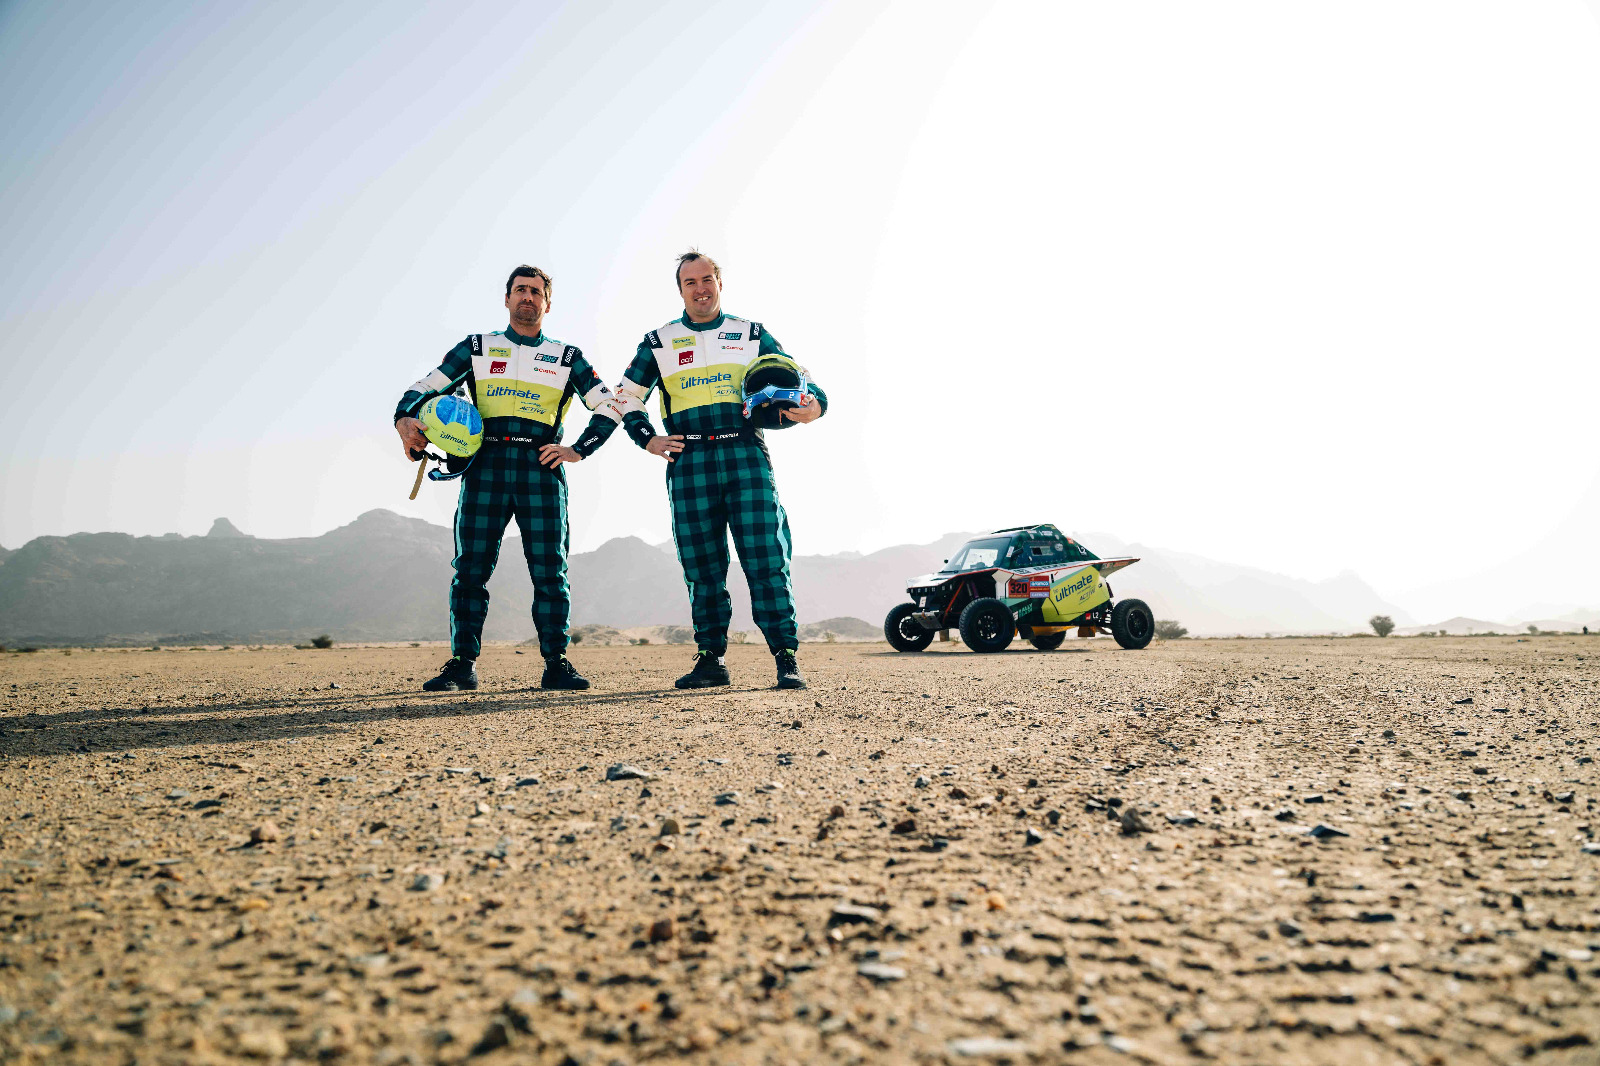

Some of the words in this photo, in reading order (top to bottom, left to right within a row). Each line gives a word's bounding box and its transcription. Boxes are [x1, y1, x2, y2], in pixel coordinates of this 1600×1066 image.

[681, 372, 732, 390] ultimate
[486, 386, 541, 401] ultimate
[519, 406, 546, 414] ACTIVE
[1010, 582, 1028, 594] 320
[1055, 574, 1093, 603] ultimate
[1092, 611, 1099, 619] L2
